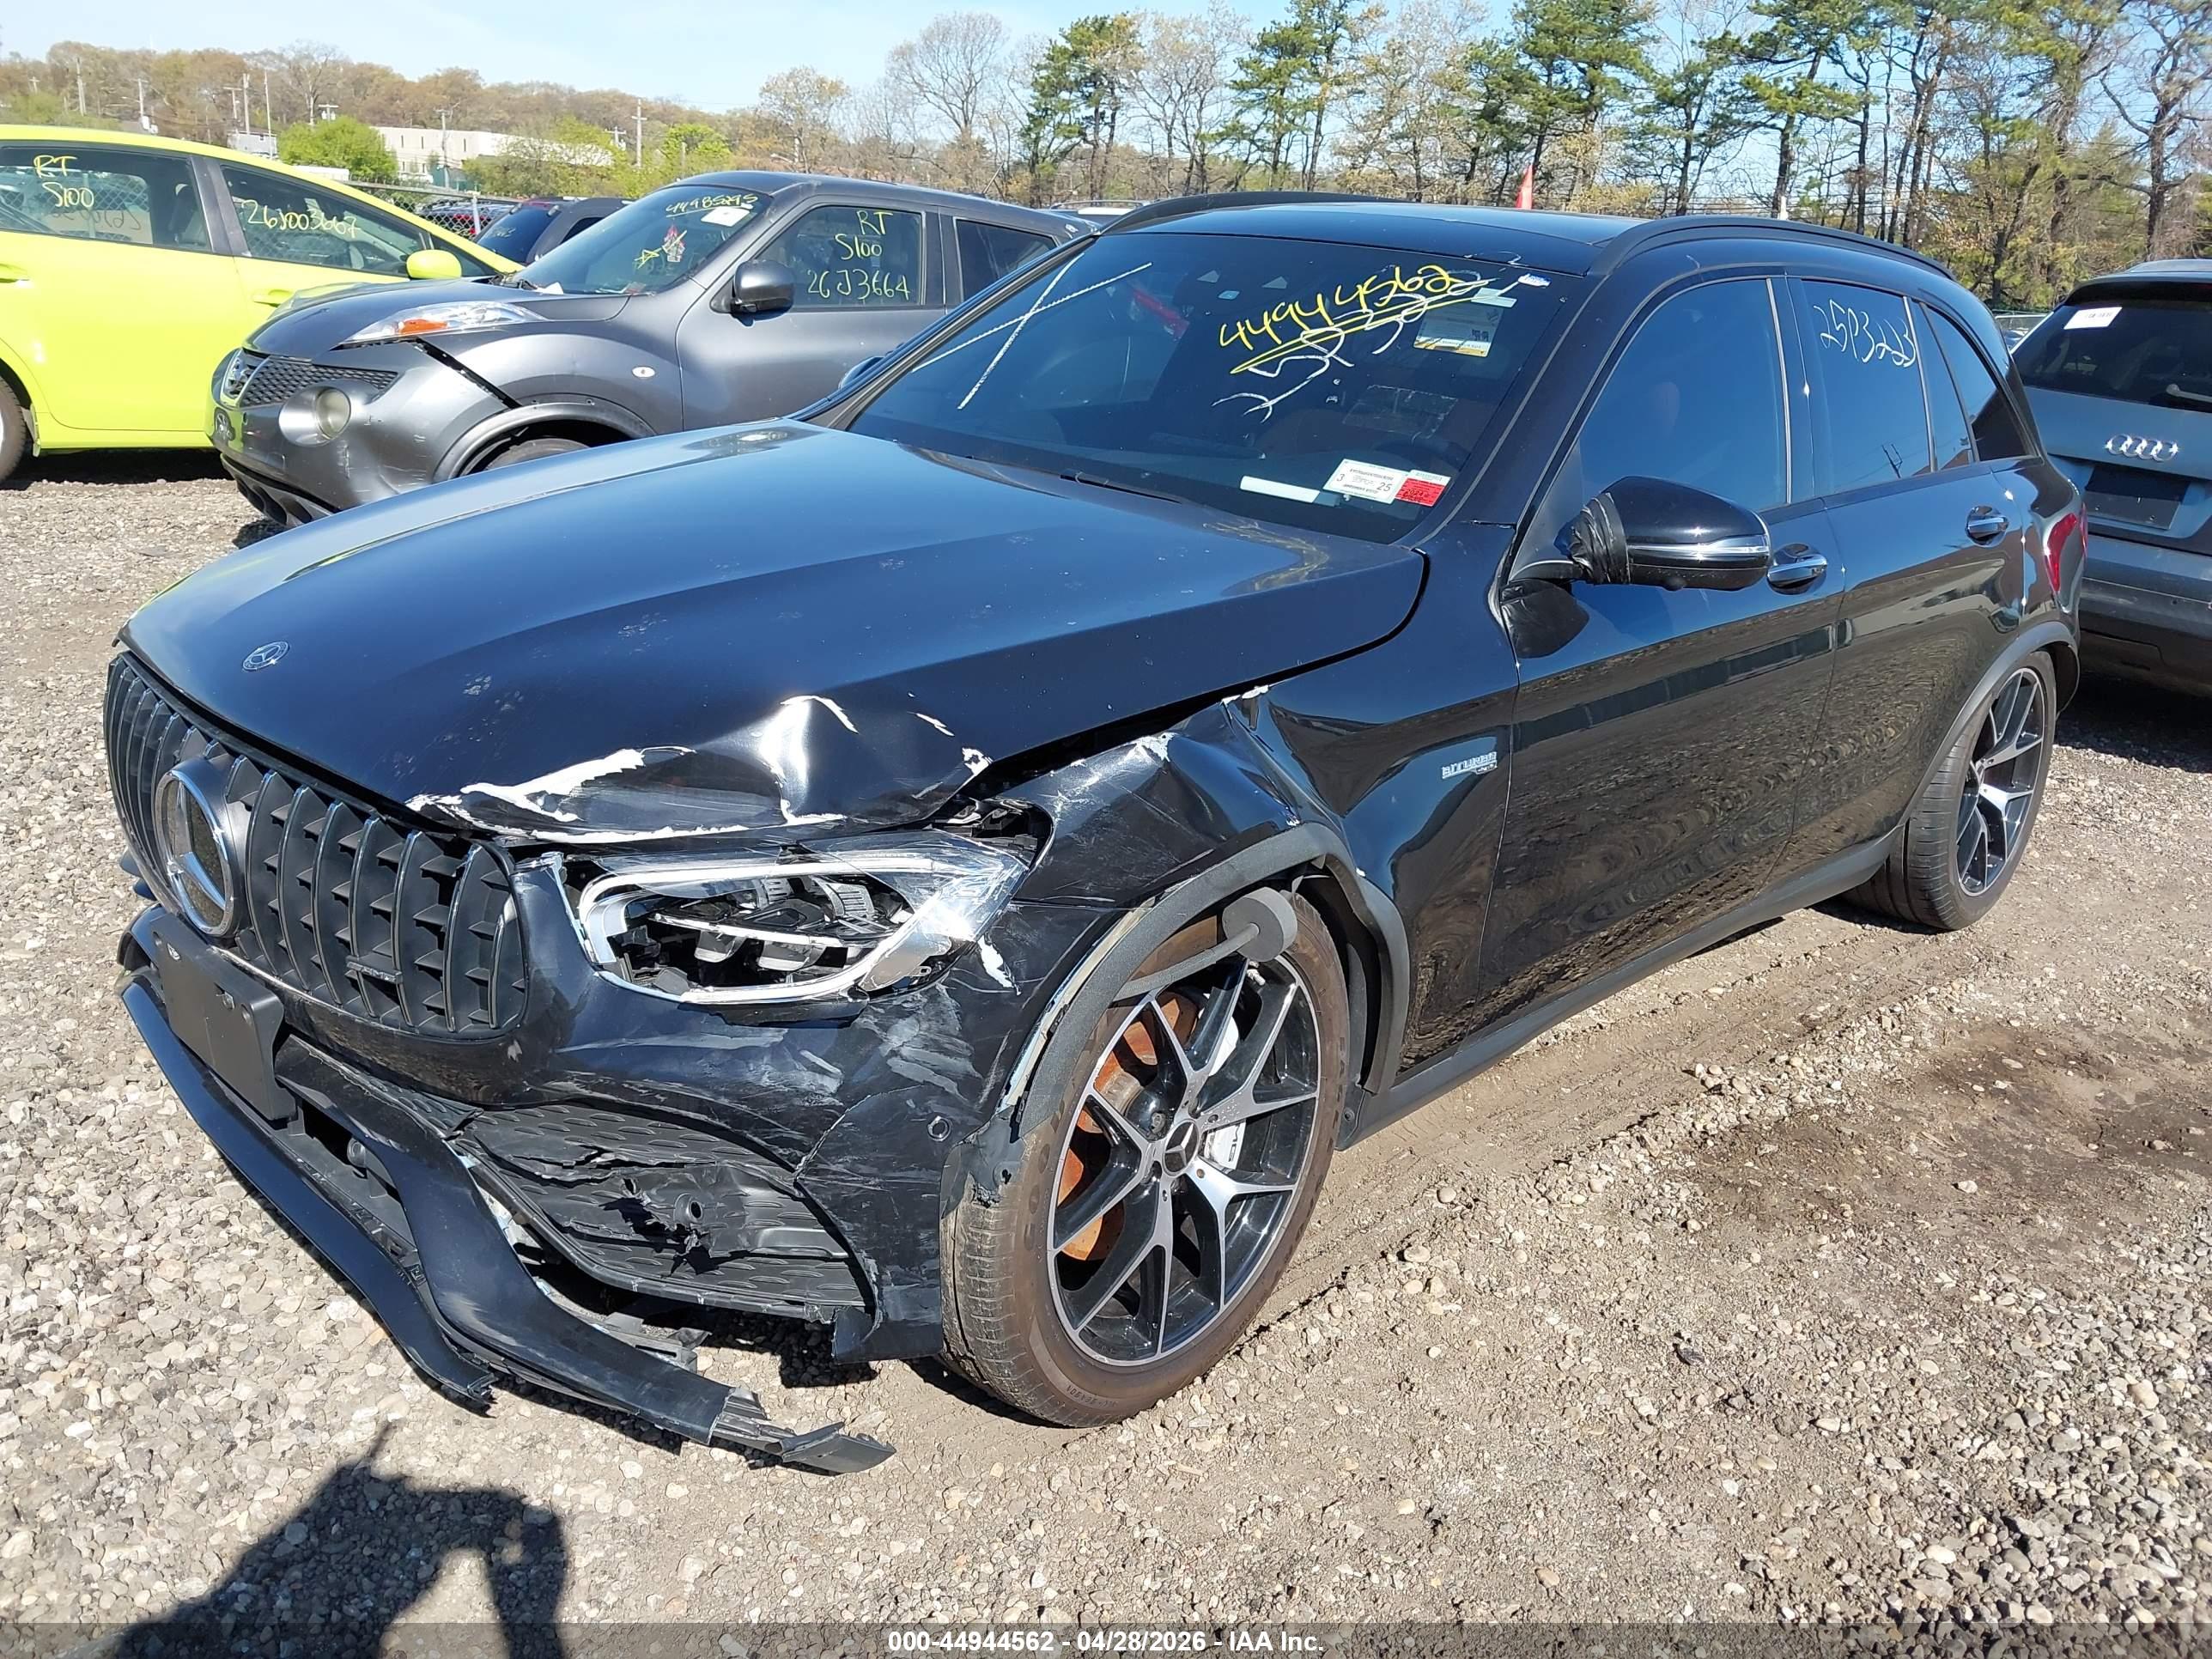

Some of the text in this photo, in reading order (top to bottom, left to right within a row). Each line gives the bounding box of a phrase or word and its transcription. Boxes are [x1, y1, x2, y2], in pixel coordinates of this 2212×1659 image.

[33, 155, 78, 179] RT
[856, 210, 894, 235] RT
[1376, 482, 1394, 493] 25
